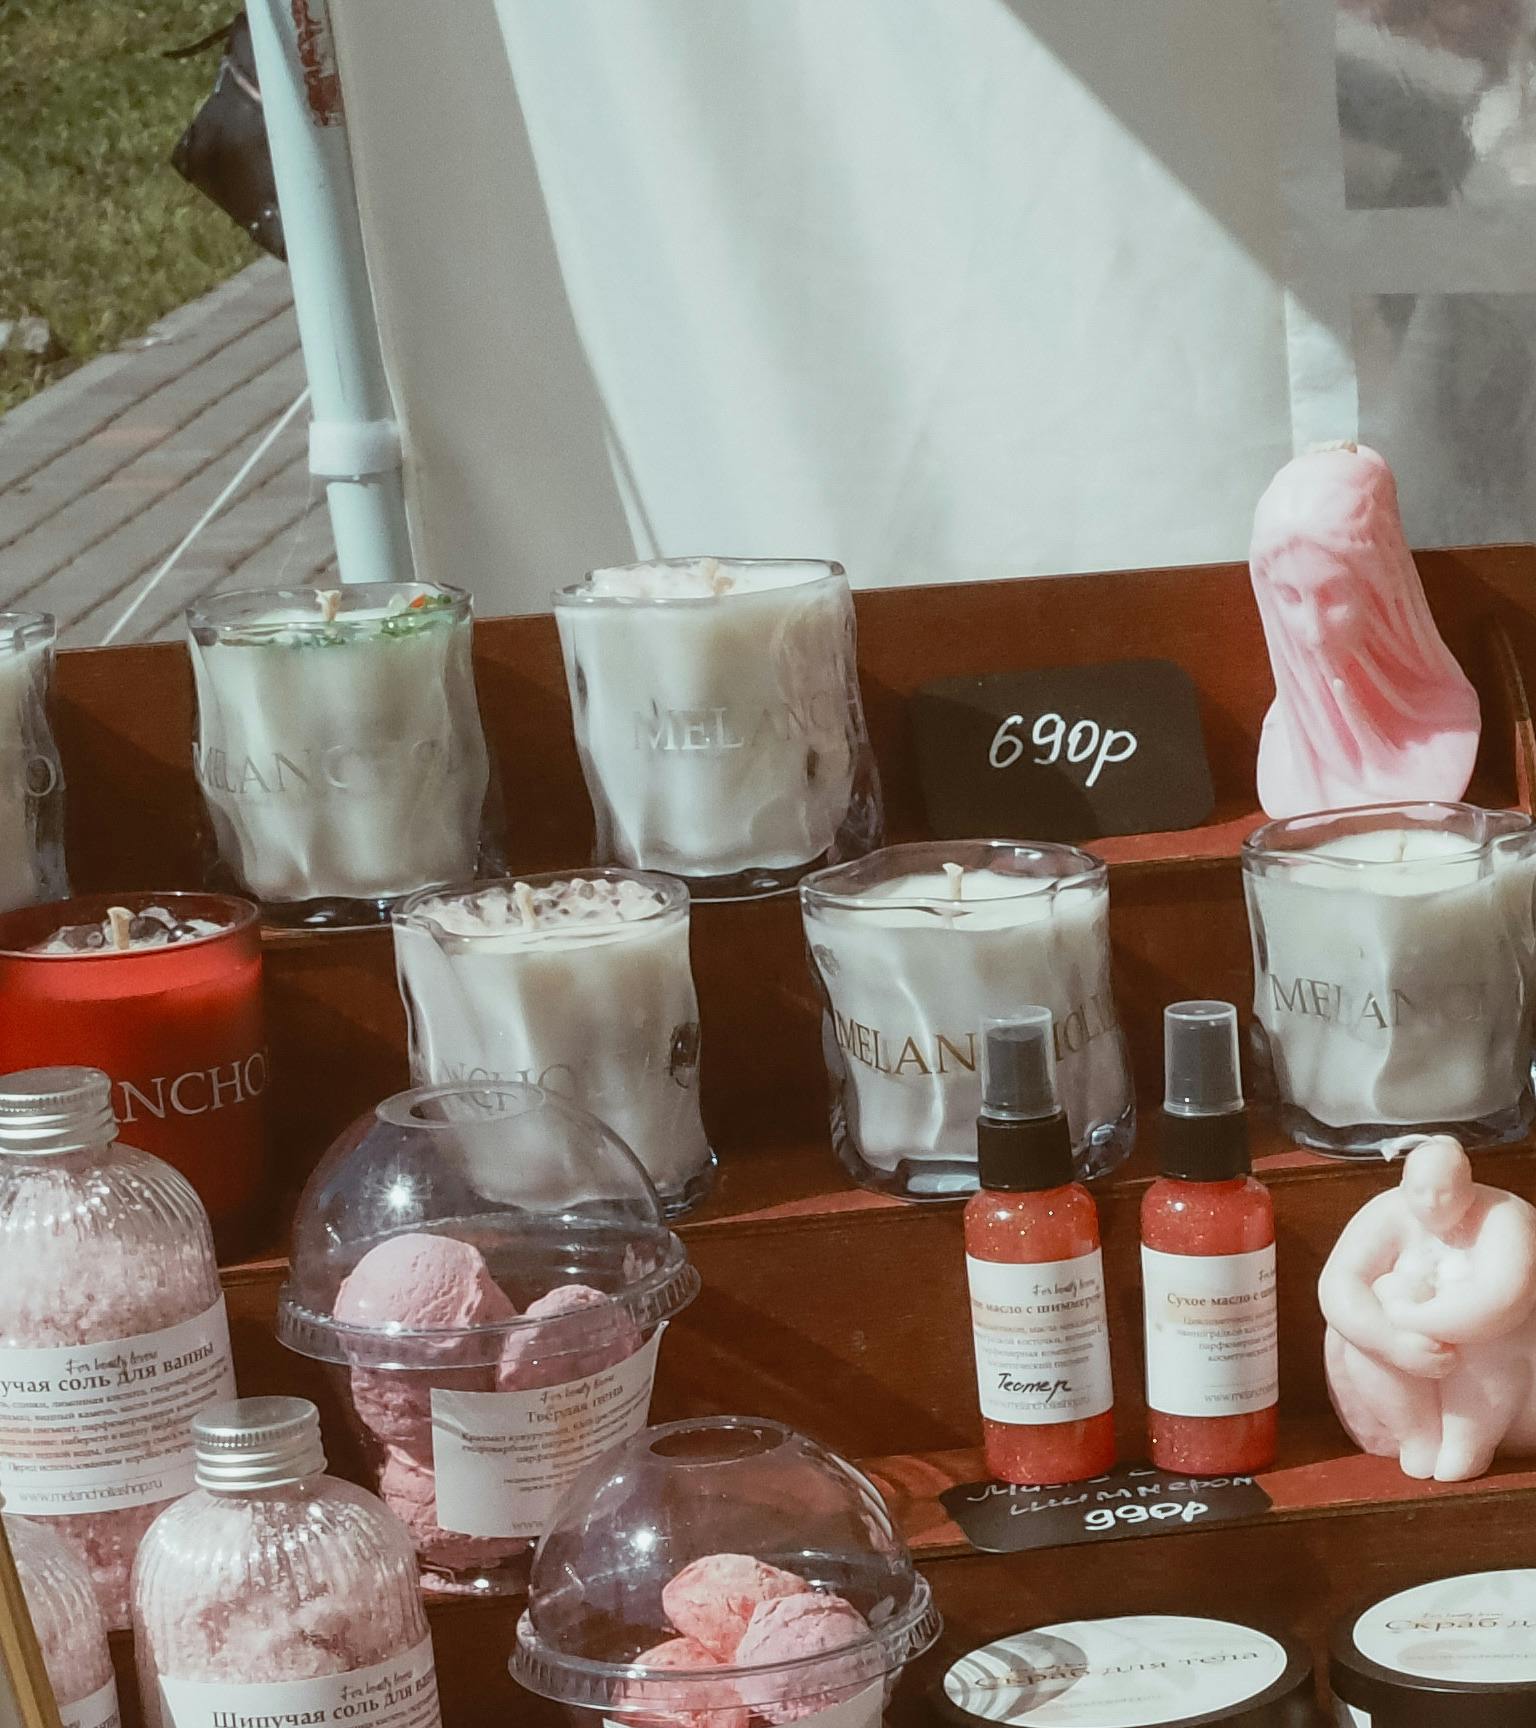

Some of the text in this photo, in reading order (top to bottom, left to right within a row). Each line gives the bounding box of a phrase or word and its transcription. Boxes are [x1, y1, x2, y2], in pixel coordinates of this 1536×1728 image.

[989, 713, 1138, 788] 690р
[1167, 1292, 1207, 1308] Сухое
[58, 1373, 111, 1392] соль
[117, 1362, 157, 1387] для
[1083, 1501, 1210, 1532] 990р
[1385, 1618, 1500, 1632] Скраб
[333, 1698, 379, 1720] соль
